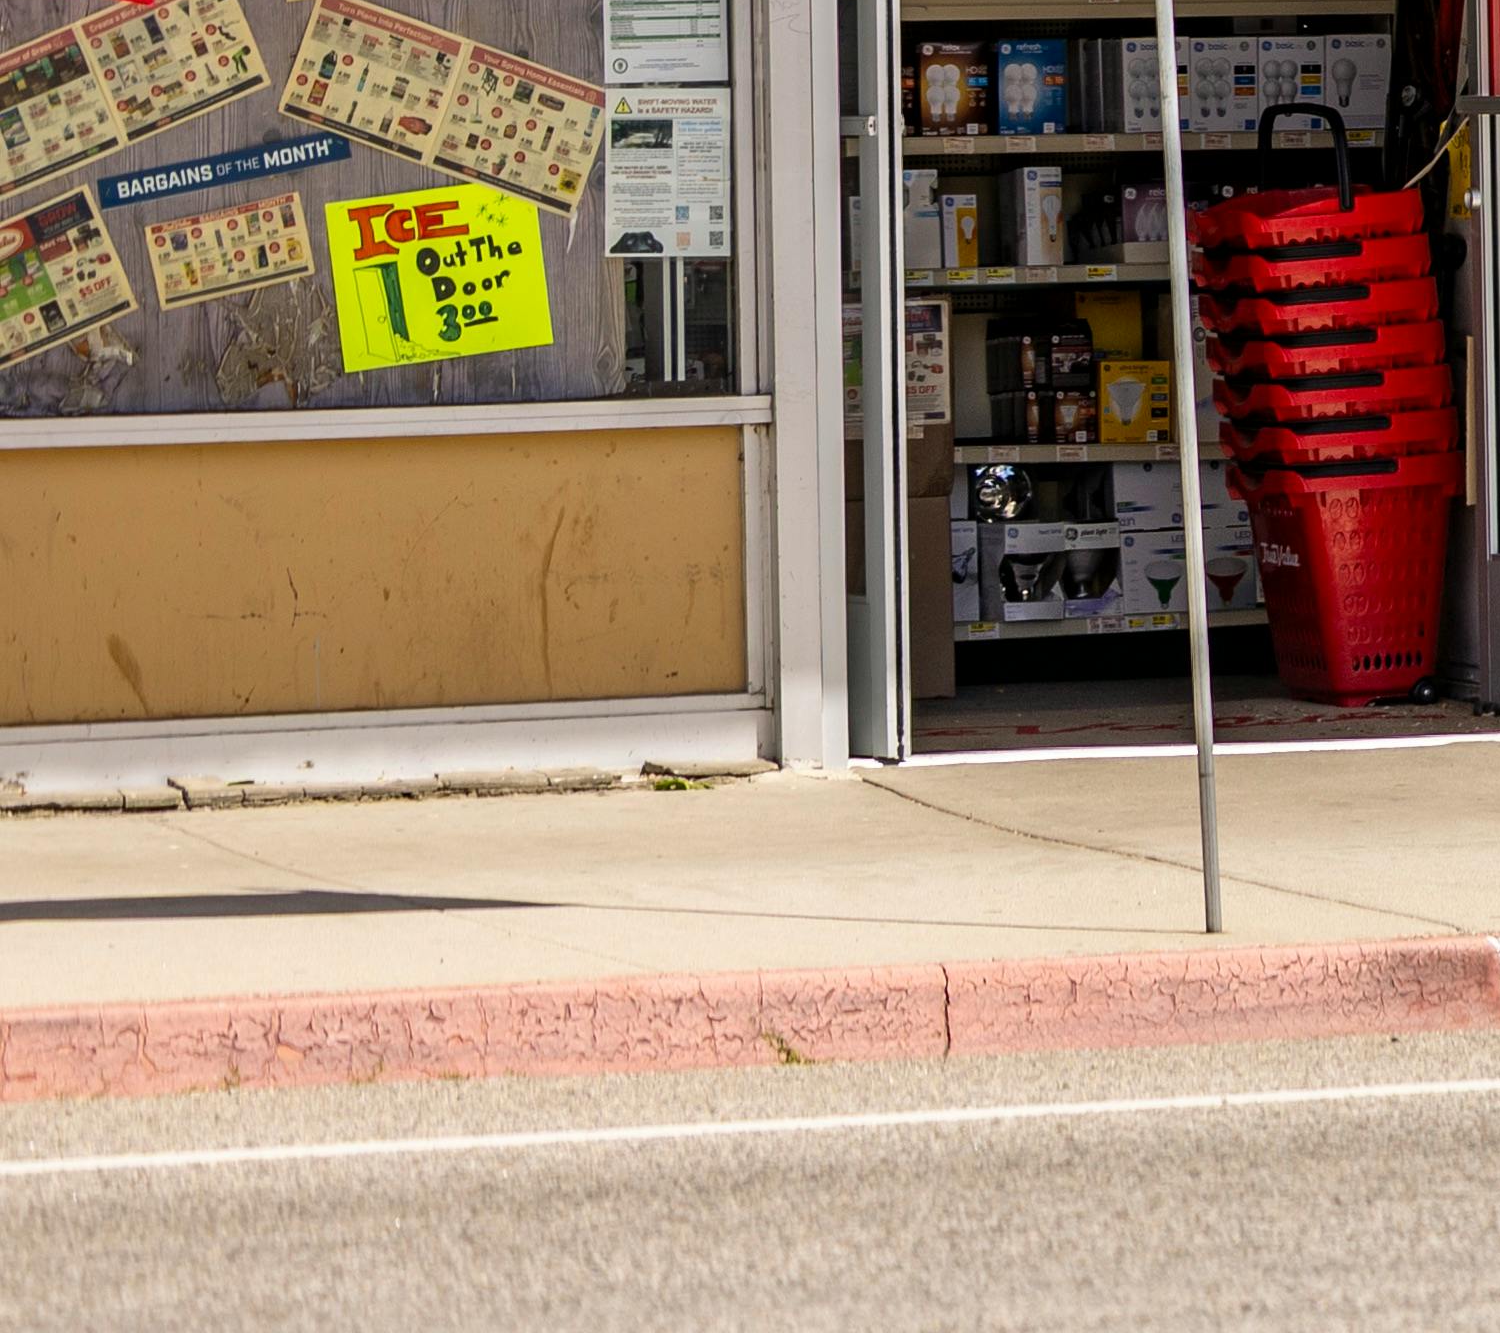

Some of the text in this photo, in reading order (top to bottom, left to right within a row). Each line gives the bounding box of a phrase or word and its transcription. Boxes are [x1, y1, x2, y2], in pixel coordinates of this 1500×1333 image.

[116, 164, 214, 200] BARGAINS
[215, 162, 234, 177] OF
[234, 157, 260, 174] THE
[347, 200, 470, 262] ICE
[416, 234, 523, 277] Out The
[431, 269, 511, 303] Door
